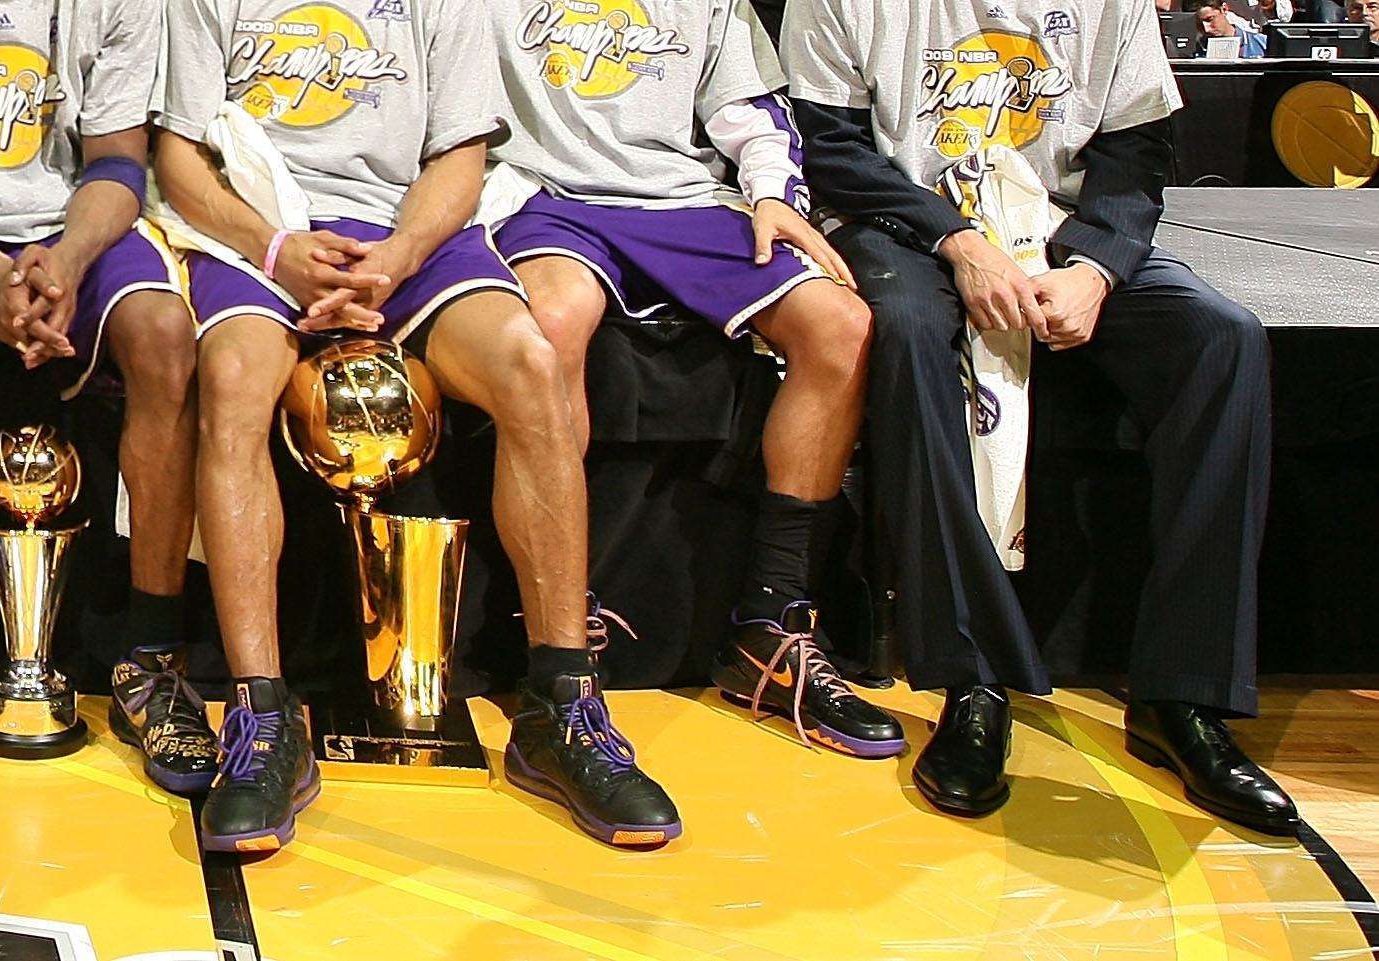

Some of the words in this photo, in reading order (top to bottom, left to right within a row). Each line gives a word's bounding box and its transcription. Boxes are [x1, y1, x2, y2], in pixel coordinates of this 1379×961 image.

[279, 23, 319, 37] NBA
[516, 2, 690, 81] Champions
[958, 50, 998, 63] NBA
